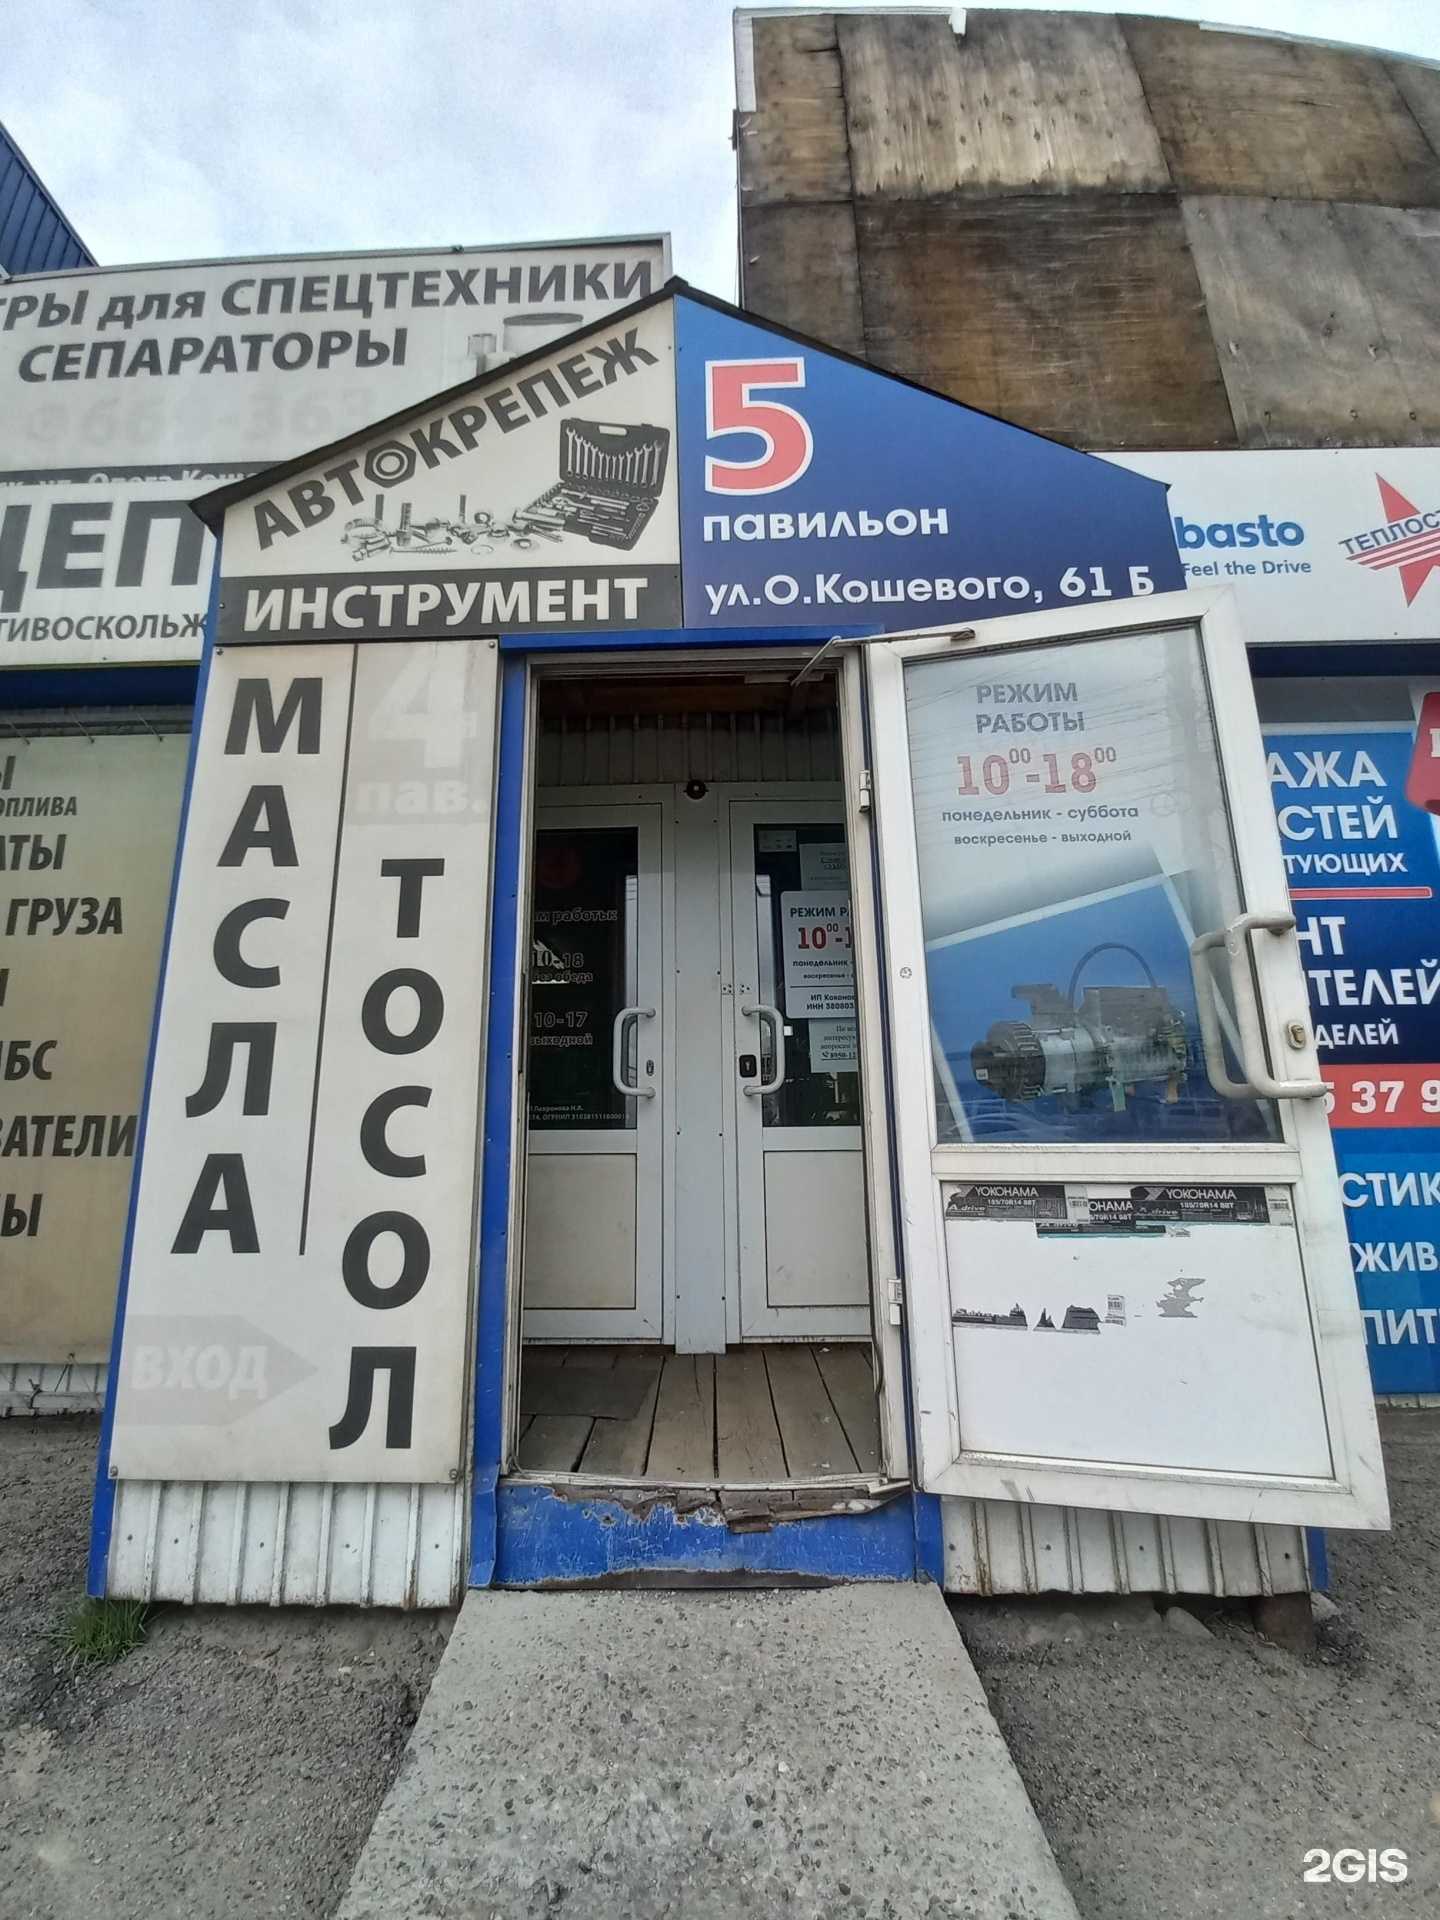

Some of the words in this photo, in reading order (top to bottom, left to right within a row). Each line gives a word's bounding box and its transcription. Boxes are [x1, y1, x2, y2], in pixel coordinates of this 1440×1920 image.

[0, 290, 89, 331] РЫ
[97, 291, 206, 331] для
[221, 260, 652, 319] СПЕЦТЕХНИКИ
[18, 327, 408, 383] СЕПАРАТОРЫ
[253, 327, 659, 550] АВТОКРЕПЕЖ
[704, 356, 814, 496] 5
[703, 508, 949, 542] павильон
[1174, 514, 1305, 549] basto
[1338, 510, 1440, 554] ТЕПЛОС
[1059, 566, 1112, 598] 61
[1128, 566, 1155, 596] Б
[1183, 561, 1218, 576] Feel
[1225, 561, 1256, 575] the
[1263, 560, 1311, 574] Drive
[244, 578, 648, 632] ИНСТРУМЕНТ
[976, 682, 1078, 704] РЕЖИМ
[976, 712, 1085, 733] РАБОТЫ
[1267, 751, 1387, 788] АЖА
[942, 809, 1051, 822] понедельник
[1068, 805, 1139, 822] суббота
[1278, 796, 1398, 841] СТЕЙ
[954, 834, 1048, 846] воскресенье
[1061, 830, 1132, 843] выходной
[1284, 853, 1408, 876] ТУЮЩИХ
[5, 897, 123, 936] ГРУЗА
[790, 907, 836, 918] РЕЖИМ
[1296, 917, 1346, 956] НТ
[171, 677, 323, 1254] МАСЛА
[1303, 959, 1440, 1006] ТЕЛЕЙ
[1315, 1018, 1399, 1049] ДЕЛЕЙ
[0, 1040, 57, 1080] БС
[1351, 1080, 1405, 1113] 37
[0, 1115, 138, 1157] АТЕЛИ
[329, 858, 445, 1449] ТОСОЛ
[975, 1187, 1039, 1197] YOKOHAMA
[1165, 1189, 1237, 1200] YOKOHAMA
[0, 1194, 43, 1236] Ы
[1350, 1242, 1440, 1272] ЖИВ
[1361, 1308, 1440, 1345] ПИТ
